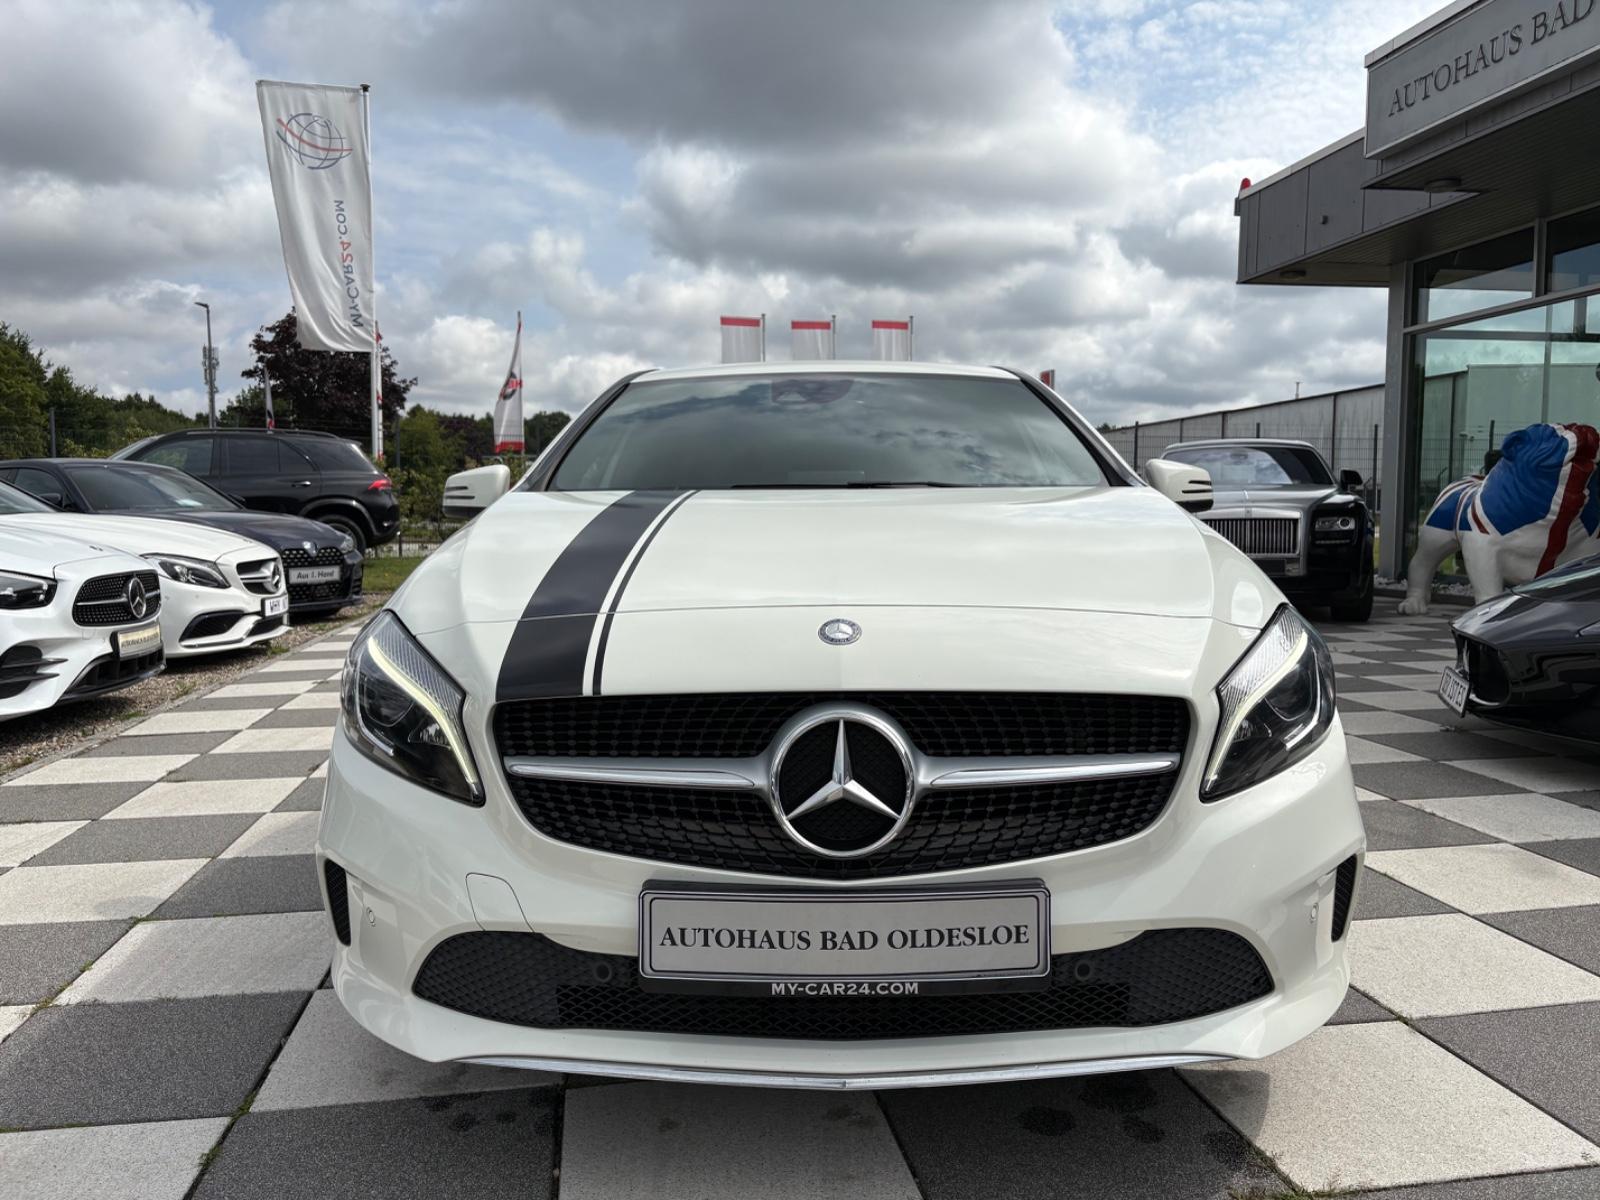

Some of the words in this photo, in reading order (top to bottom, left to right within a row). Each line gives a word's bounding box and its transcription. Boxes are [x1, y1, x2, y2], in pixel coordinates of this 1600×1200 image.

[1388, 24, 1523, 117] AUTOHAUS
[1531, 0, 1595, 45] BAD
[659, 926, 811, 951] AUTOHAUS
[819, 930, 879, 951] BAD
[887, 924, 1030, 950] OLDESLOE
[771, 982, 919, 996] MY-CAR24.COM
